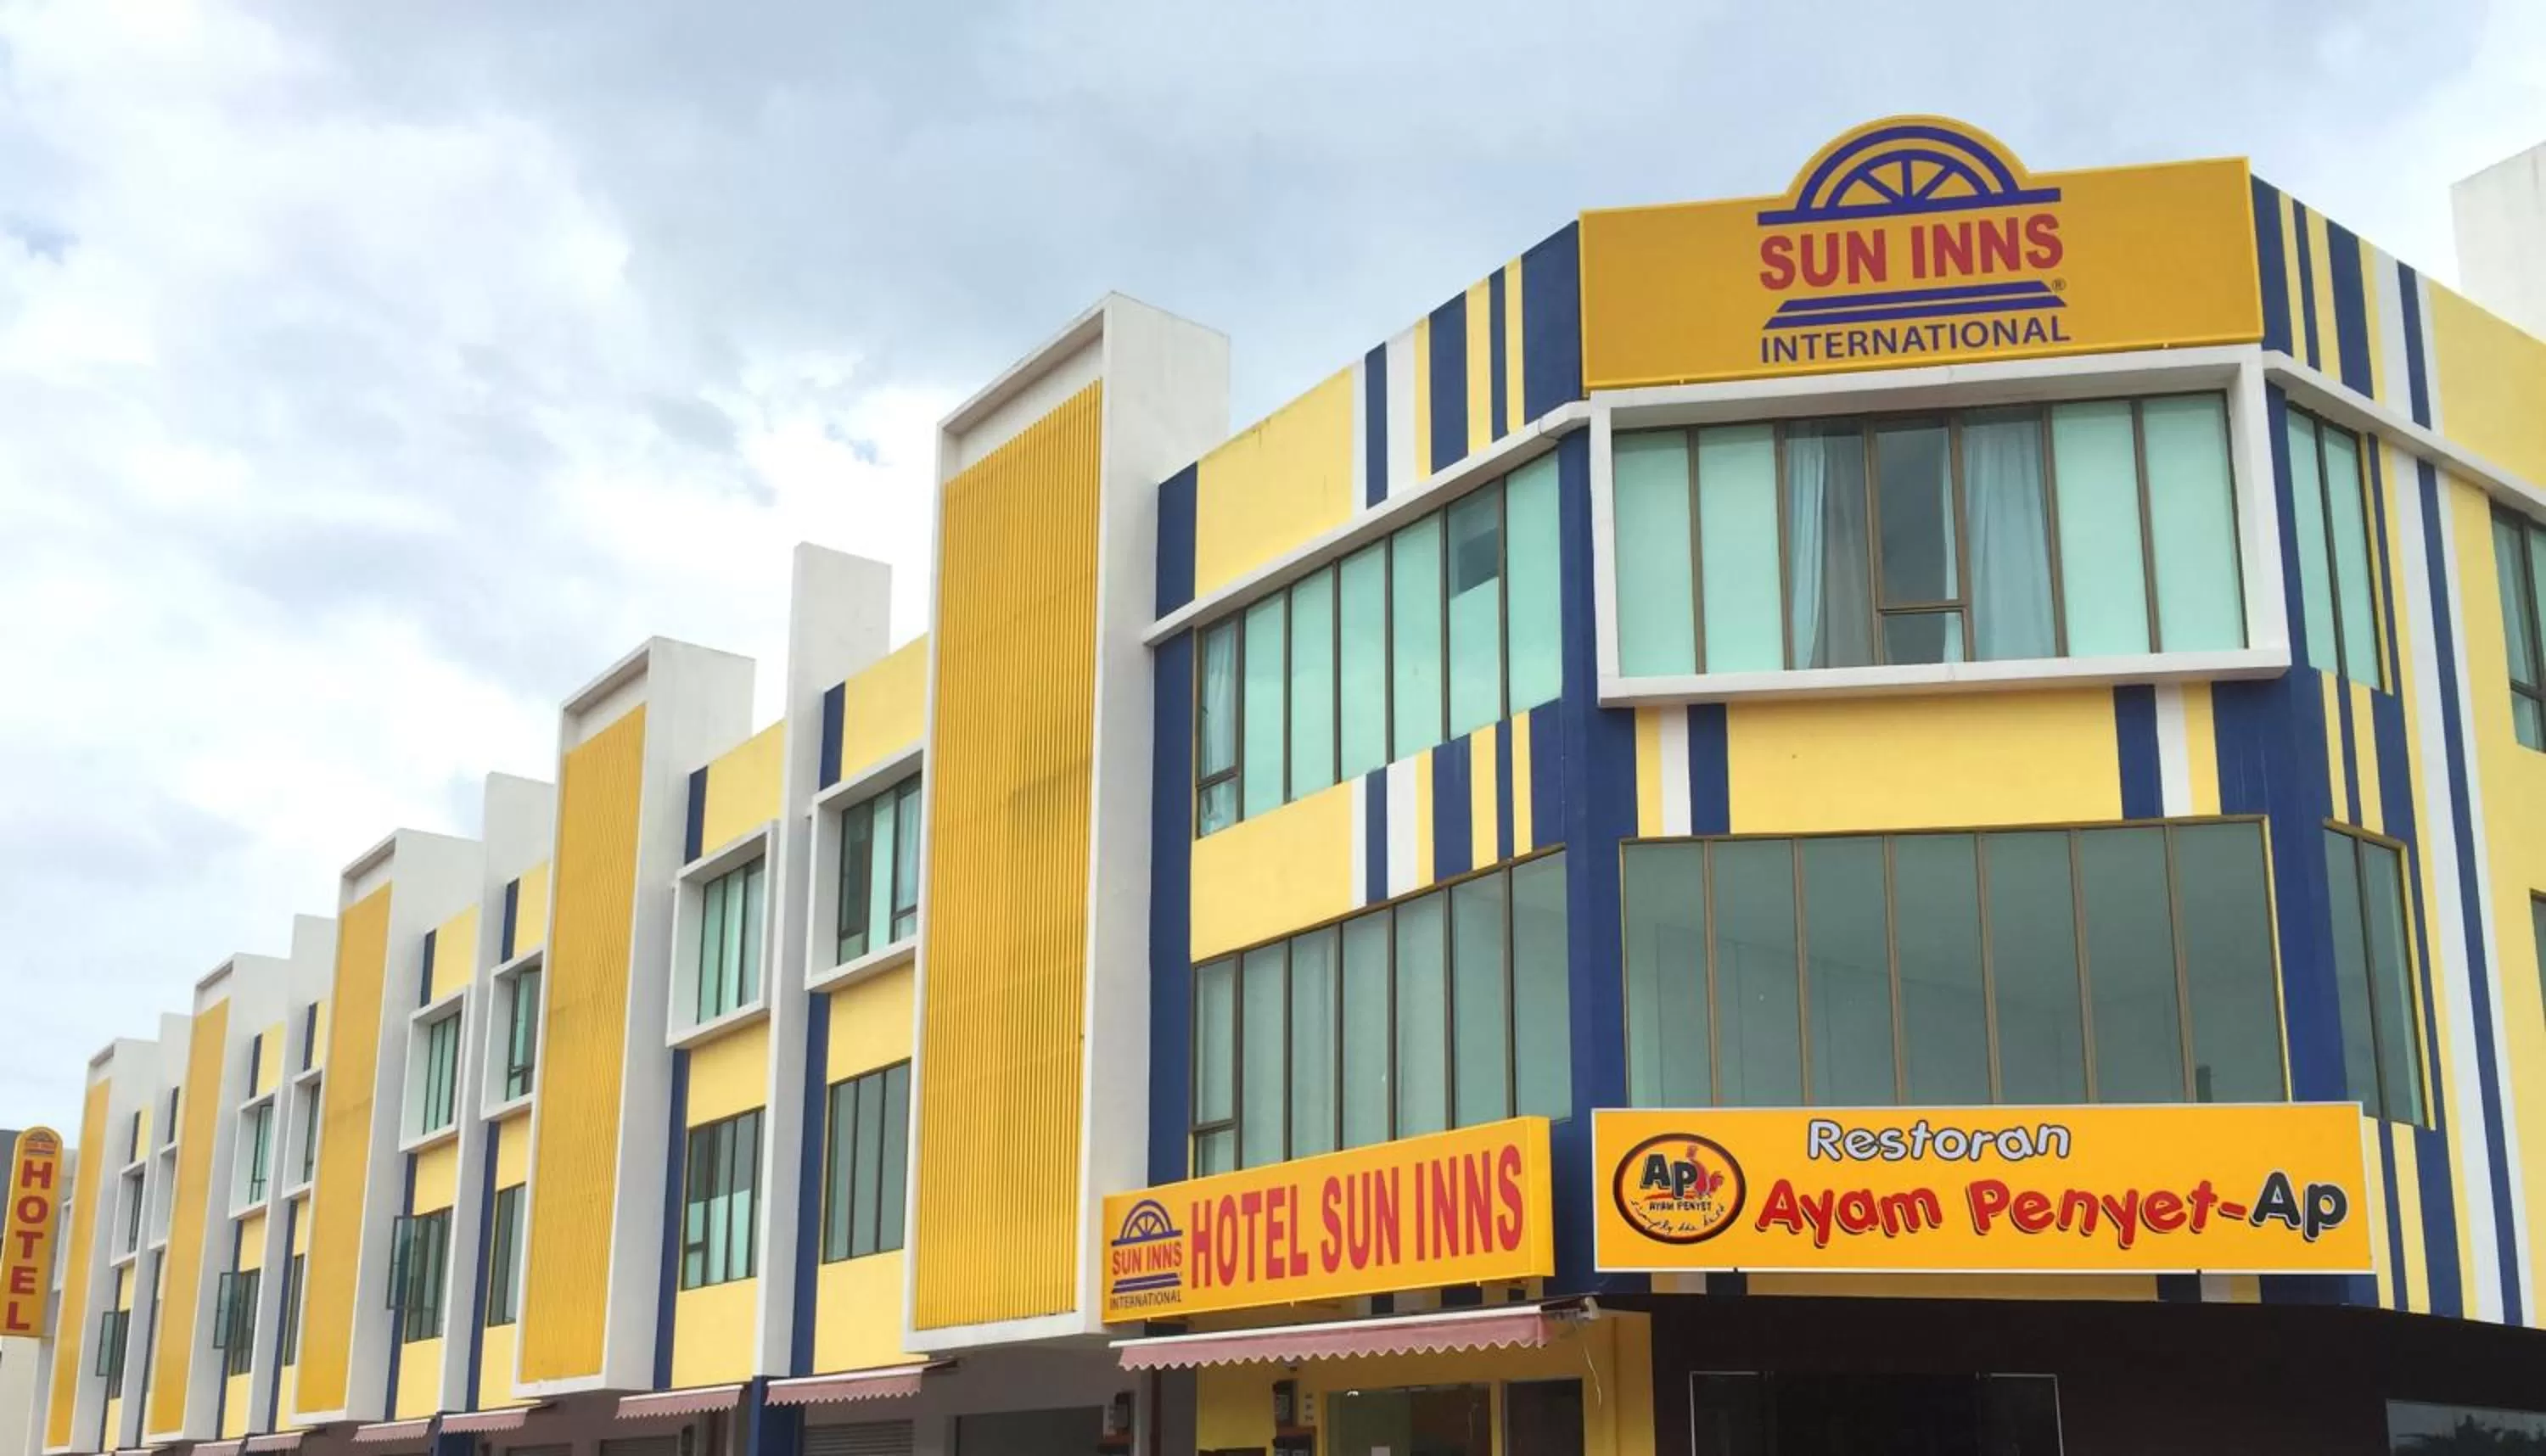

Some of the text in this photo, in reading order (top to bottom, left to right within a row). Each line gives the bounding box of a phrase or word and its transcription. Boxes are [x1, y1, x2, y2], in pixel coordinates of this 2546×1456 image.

[1759, 213, 2064, 291] SUN INNS
[1761, 315, 2071, 364] INTERNATIONAL
[1808, 1119, 2071, 1162] Restoran
[1640, 1153, 1698, 1201] Ap
[1192, 1145, 1523, 1290] HOTEL SUN INNS
[1676, 1201, 1712, 1211] PENYET
[1755, 1168, 2348, 1250] Ayam Penyet-Ap
[6, 1160, 53, 1331] HOTEL
[1113, 1241, 1182, 1275] SUN INNS
[1109, 1290, 1182, 1310] INTERNATIONAL
